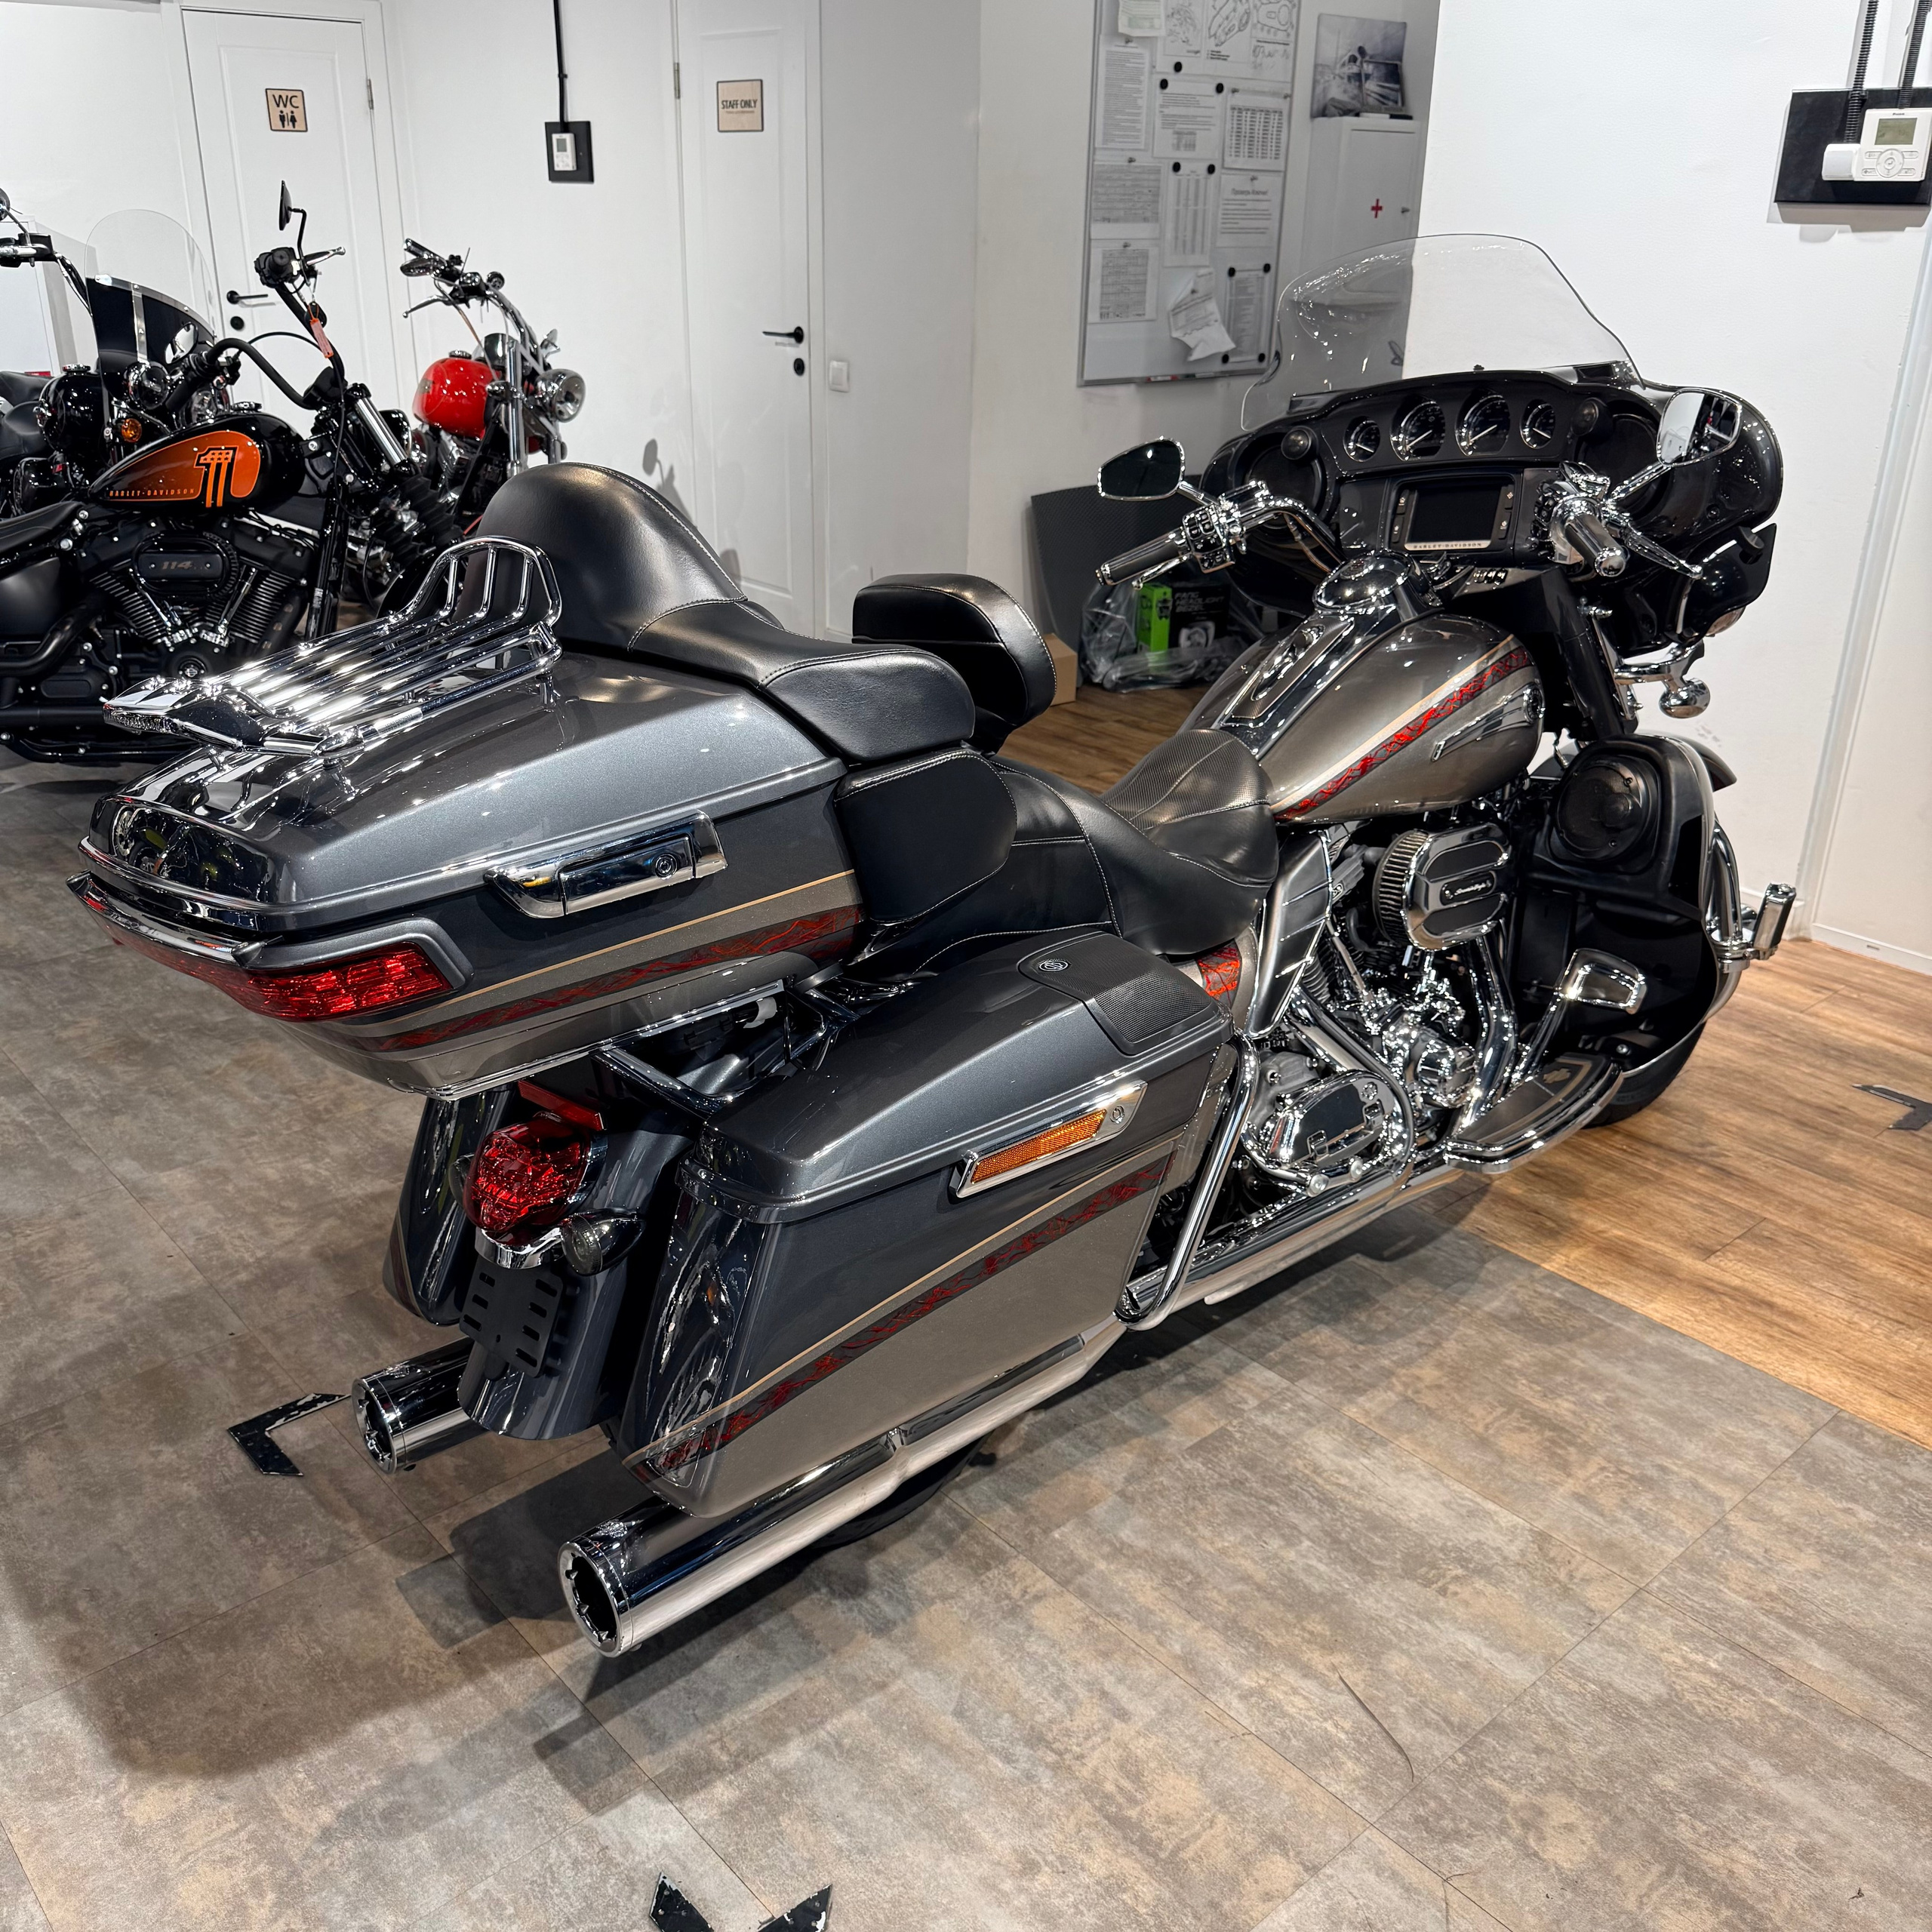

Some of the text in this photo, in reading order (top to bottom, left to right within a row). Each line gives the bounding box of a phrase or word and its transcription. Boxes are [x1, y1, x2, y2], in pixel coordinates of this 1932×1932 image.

[272, 94, 300, 109] WC
[721, 98, 758, 109] STAFF ONLY
[109, 488, 195, 497] HARLEY-DAVIDSON
[162, 561, 193, 570] 114
